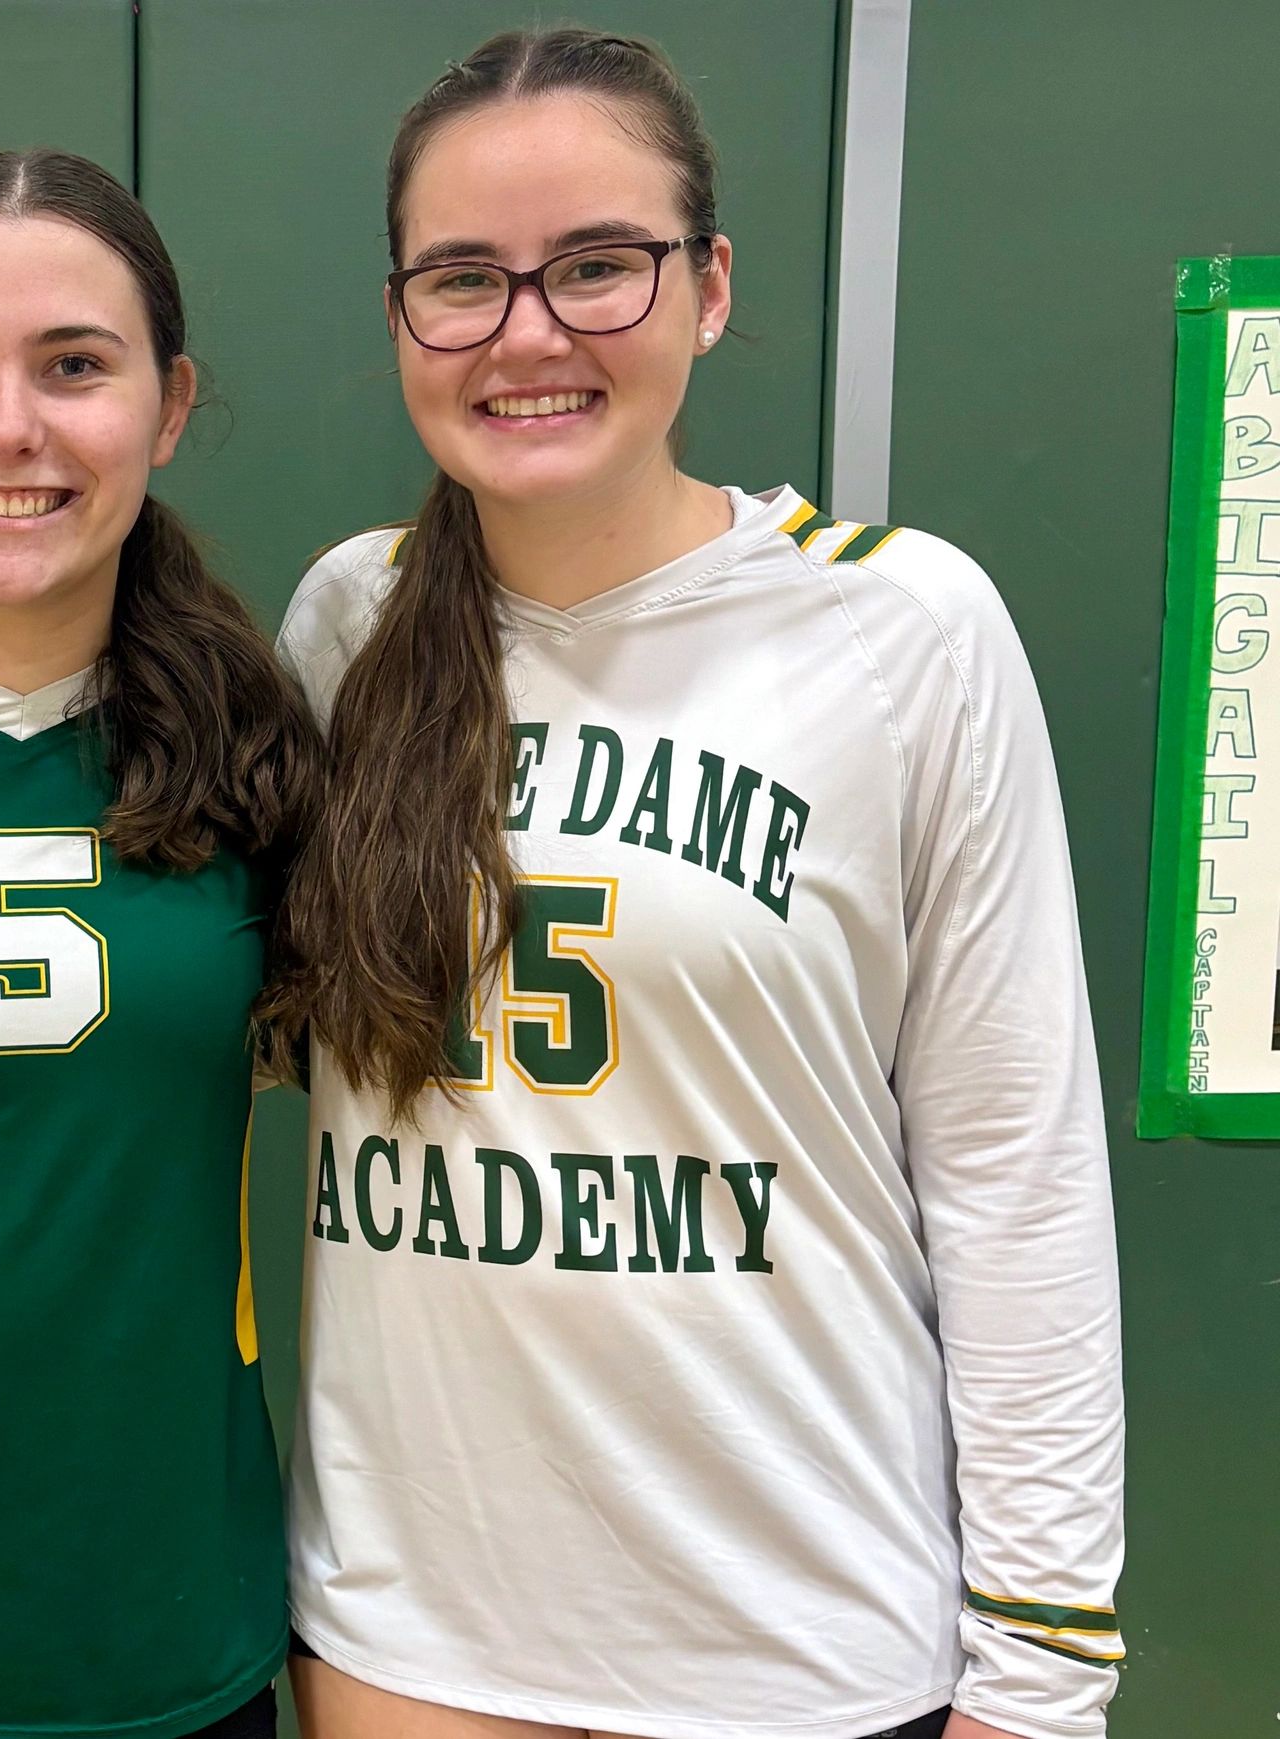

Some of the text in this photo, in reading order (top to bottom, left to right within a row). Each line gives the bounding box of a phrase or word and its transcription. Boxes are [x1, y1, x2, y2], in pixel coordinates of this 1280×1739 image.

[1197, 316, 1280, 914] ABIGAIL
[560, 724, 811, 923] DAME
[1189, 928, 1217, 1092] CAPTAIN
[312, 1131, 779, 1275] ACADEMY
